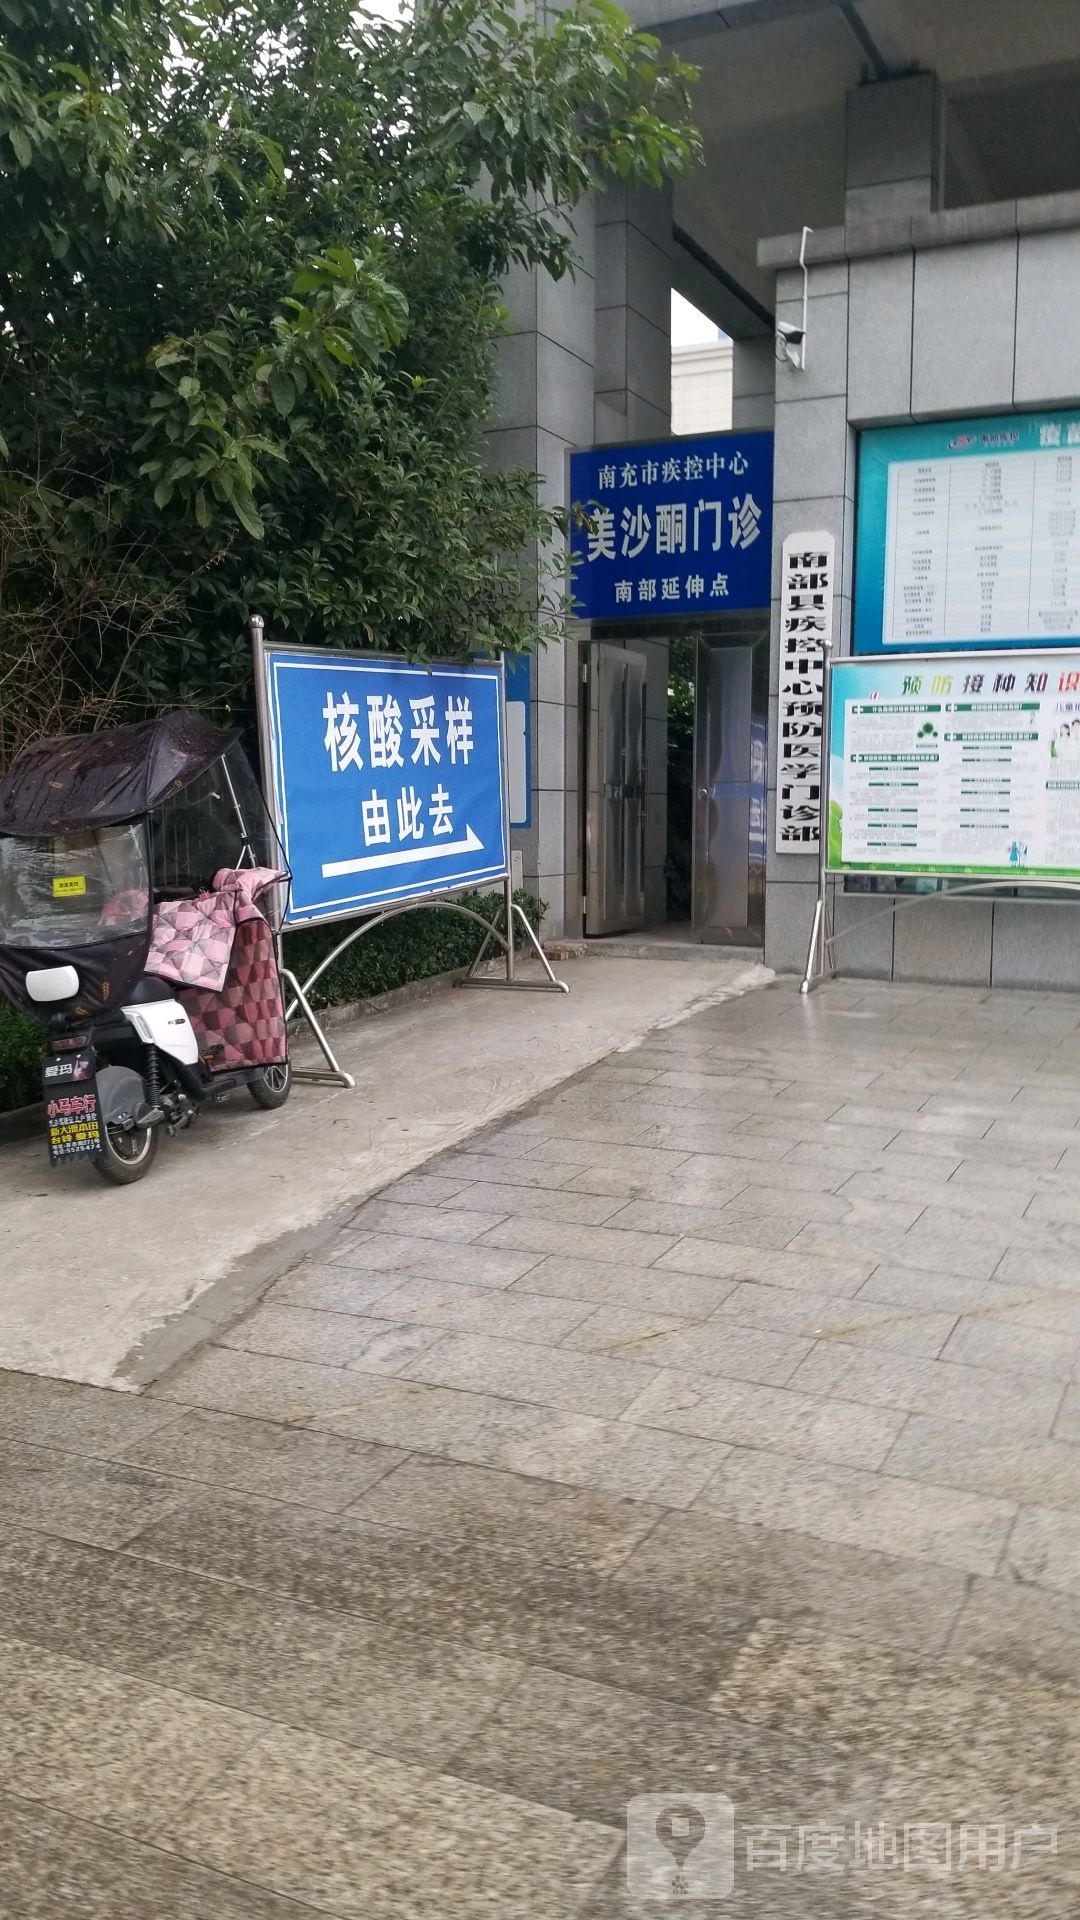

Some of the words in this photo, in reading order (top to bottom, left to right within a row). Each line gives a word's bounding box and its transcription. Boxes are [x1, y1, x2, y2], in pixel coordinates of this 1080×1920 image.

[598, 451, 749, 490] 南充市疾控中心
[587, 493, 762, 562] 美沙酮门诊
[614, 572, 729, 603] 南部延伸点
[780, 552, 829, 842] 南部县疾控中心预防医学门诊部
[902, 671, 1080, 695] 预防接种知识
[322, 691, 474, 772] 核酸采样
[361, 783, 454, 846] 由此去
[45, 1063, 73, 1078] 爱玛
[47, 1094, 96, 1118] 小马车行
